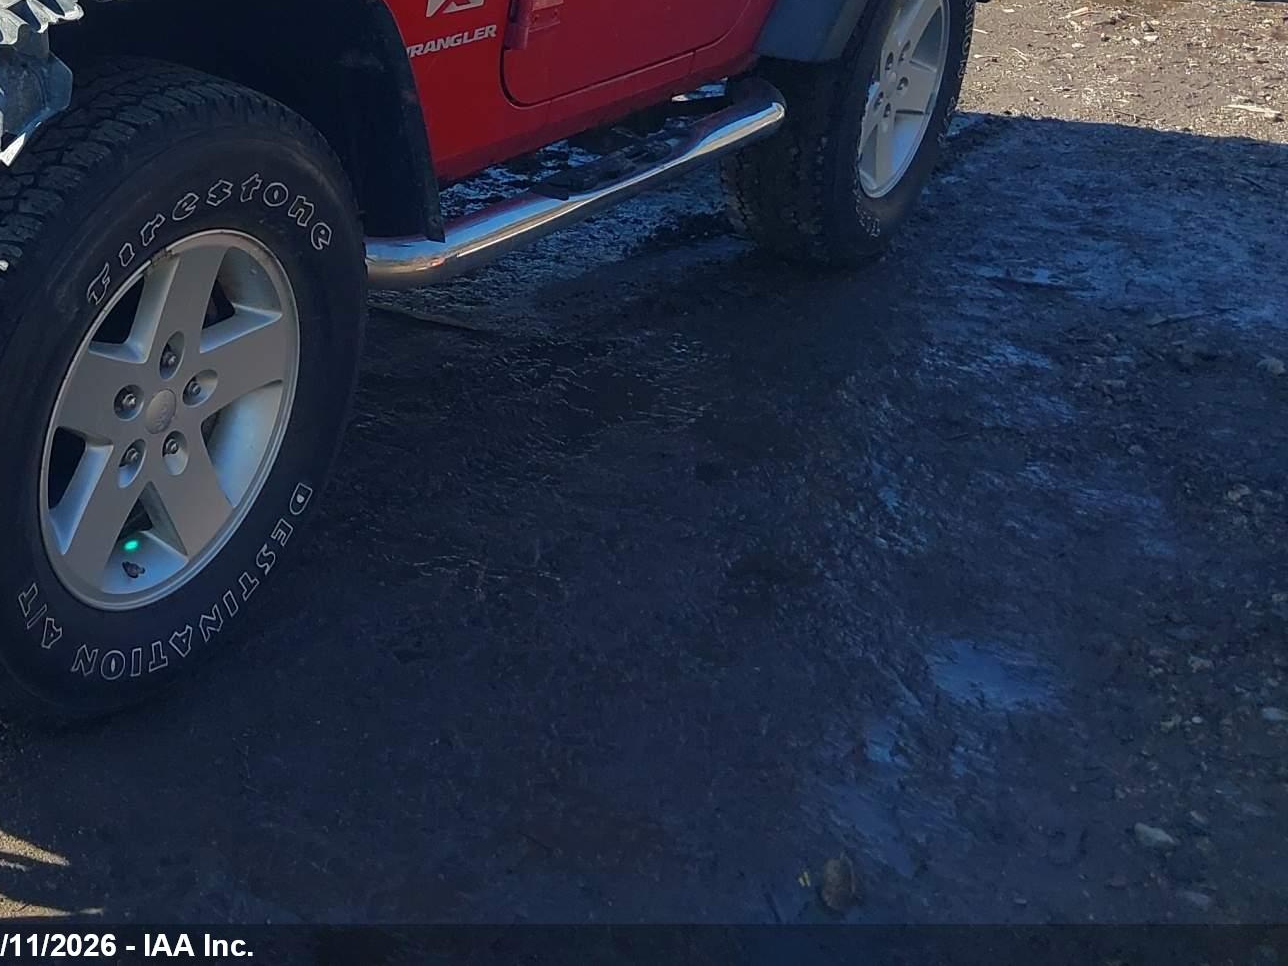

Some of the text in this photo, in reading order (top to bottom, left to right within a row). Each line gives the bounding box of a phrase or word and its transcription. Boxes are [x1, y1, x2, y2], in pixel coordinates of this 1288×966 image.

[406, 24, 497, 59] RANGLER
[87, 173, 333, 306] Firestone
[18, 482, 313, 681] DESTINATION A/T
